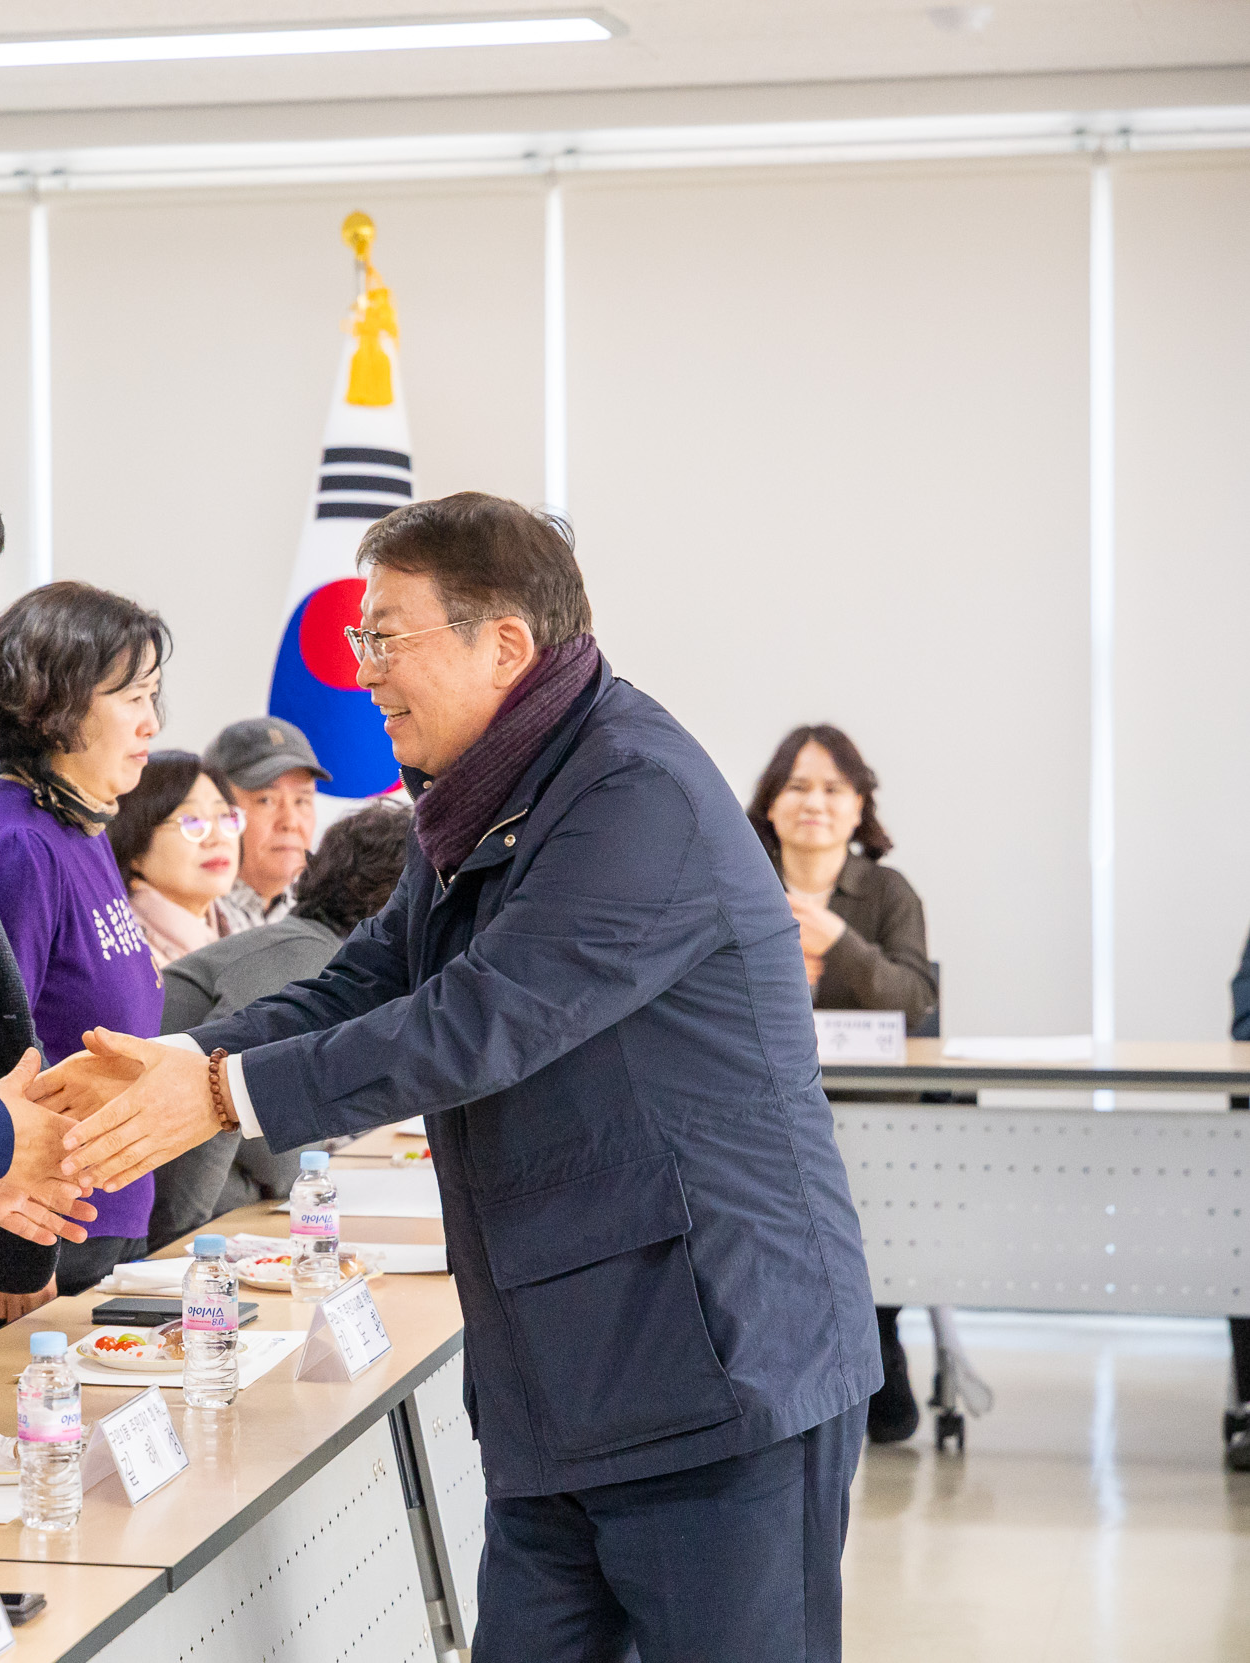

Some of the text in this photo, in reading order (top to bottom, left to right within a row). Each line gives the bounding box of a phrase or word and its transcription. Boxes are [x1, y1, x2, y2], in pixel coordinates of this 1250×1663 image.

[301, 1214, 333, 1224] 아이시스
[187, 1306, 225, 1318] 아이시스
[211, 1317, 225, 1326] 8.0
